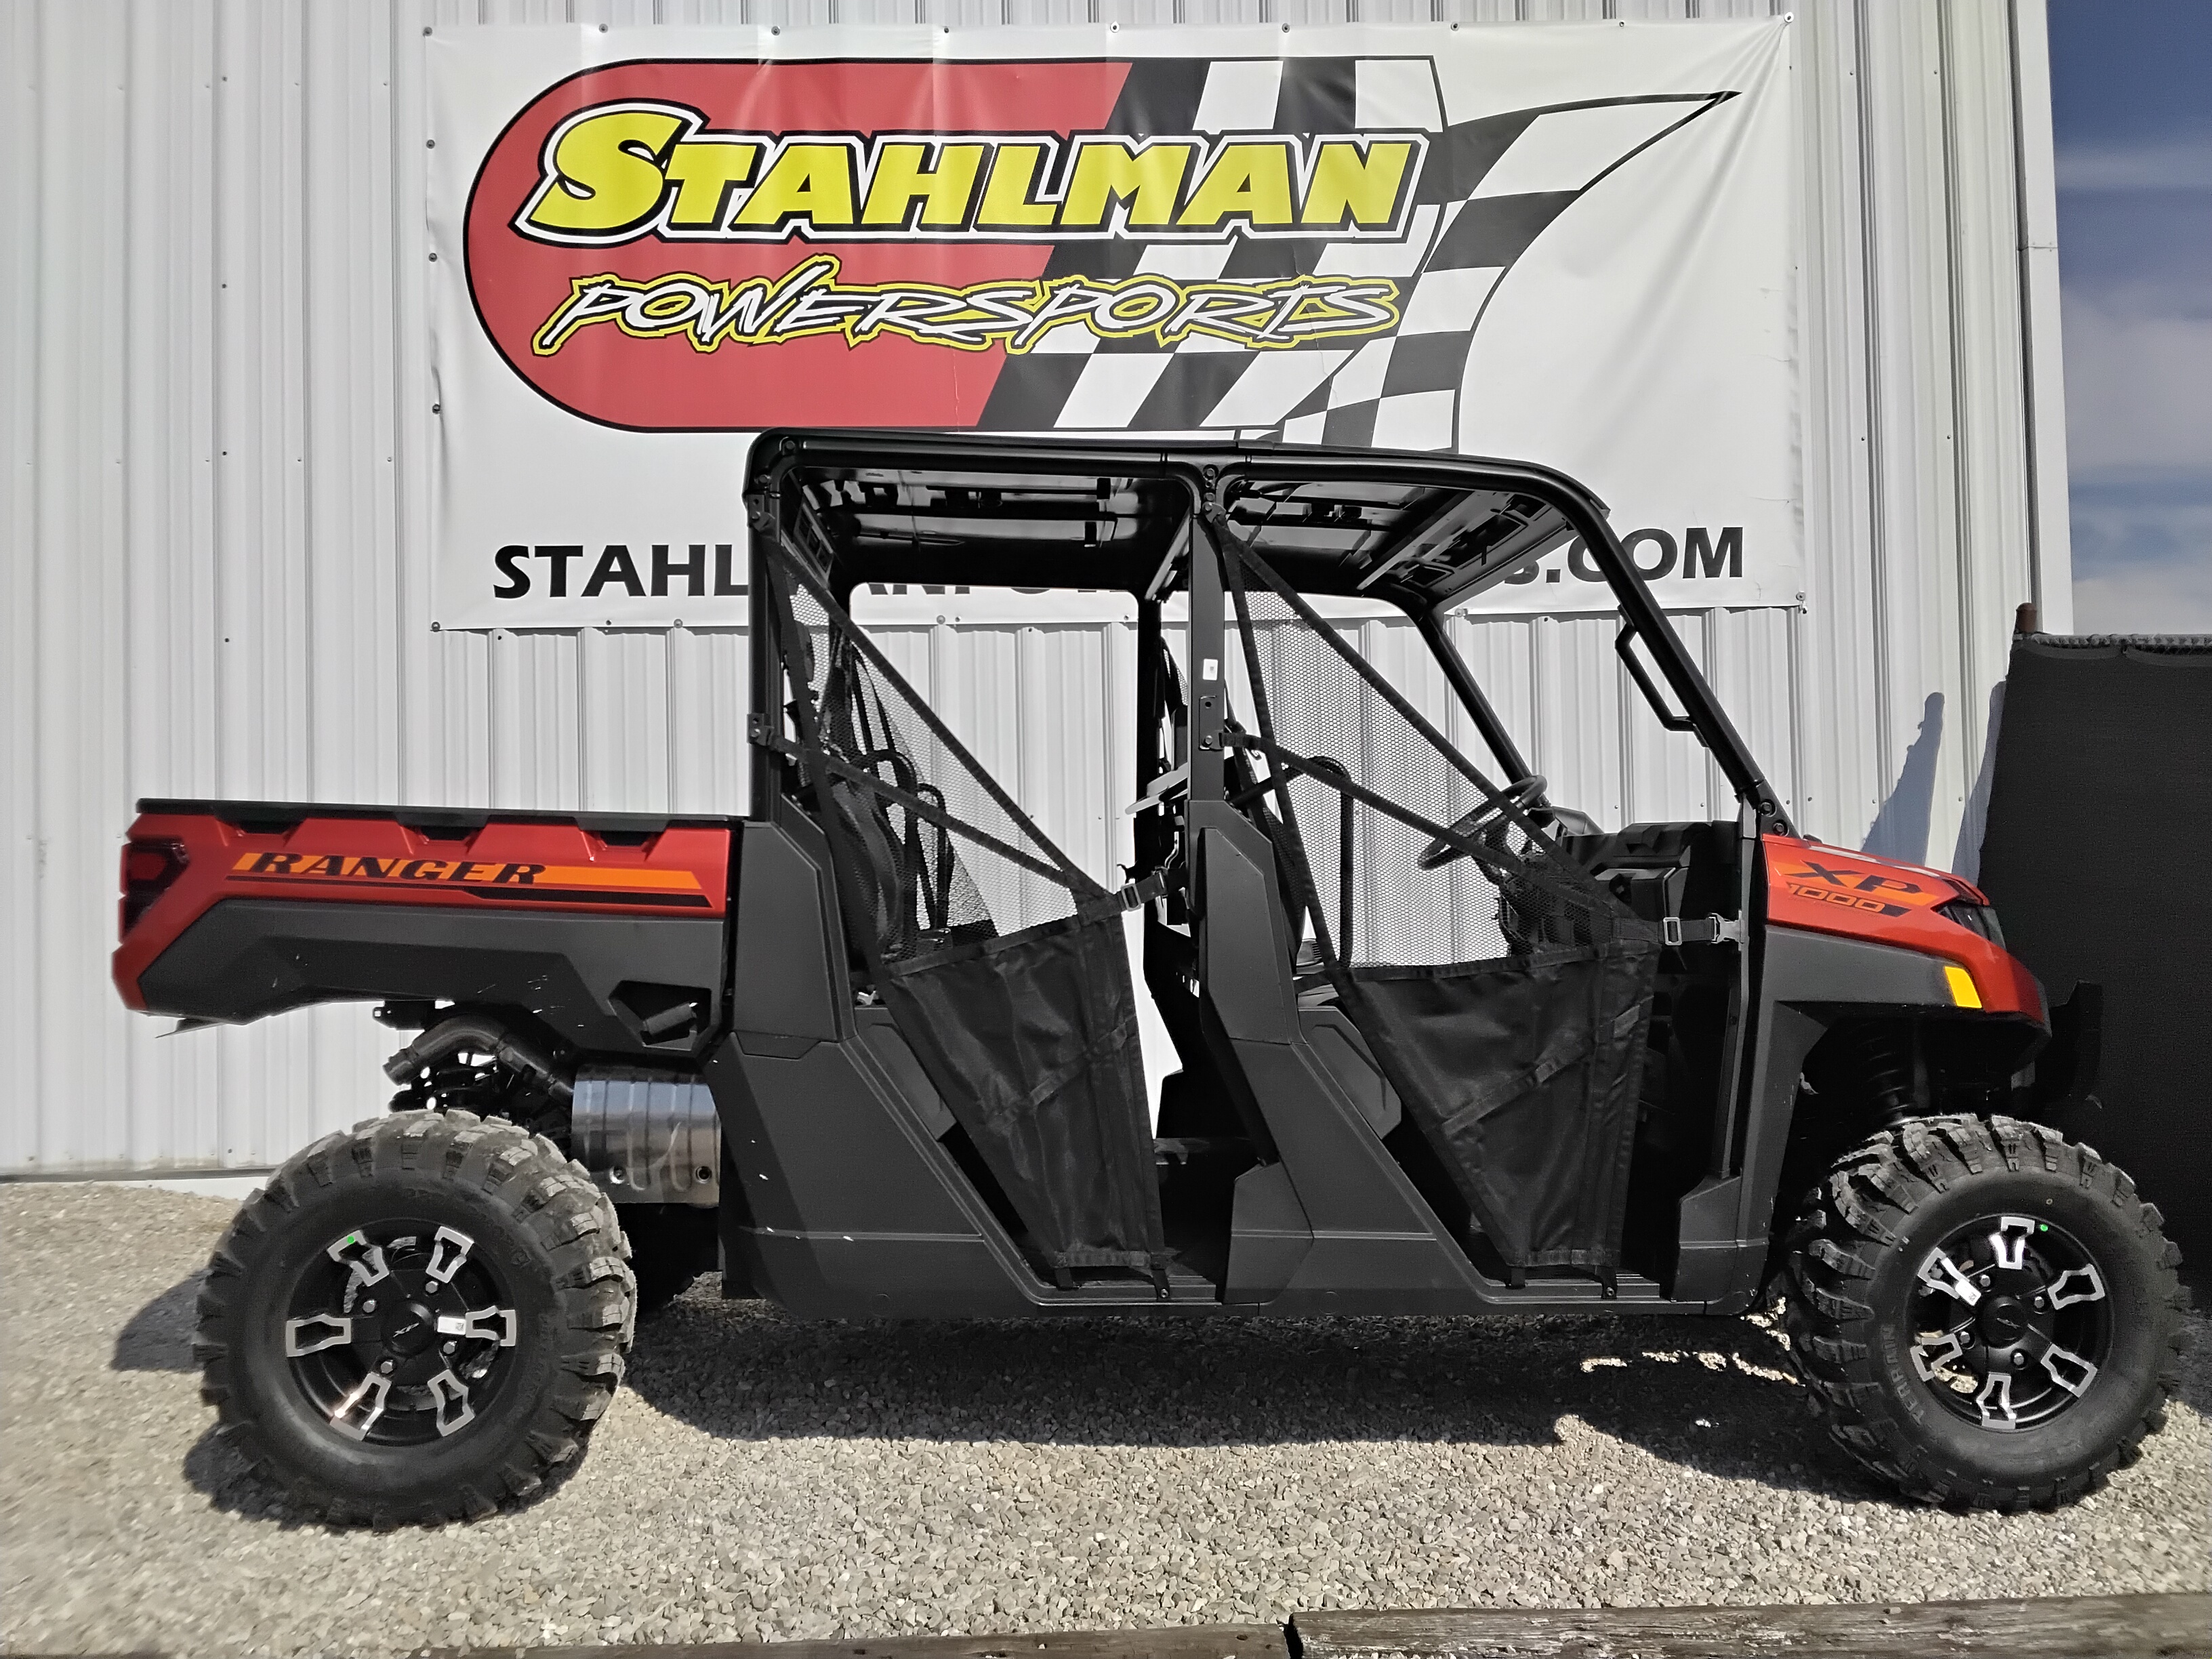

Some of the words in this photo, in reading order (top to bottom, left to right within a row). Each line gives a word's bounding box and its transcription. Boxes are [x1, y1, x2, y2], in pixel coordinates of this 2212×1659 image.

[513, 102, 1429, 245] STAHLMAN
[532, 255, 1401, 354] POWERSPORTS
[248, 852, 546, 885] RANGER
[1784, 861, 1923, 893] XP
[1786, 883, 1885, 914] 1000
